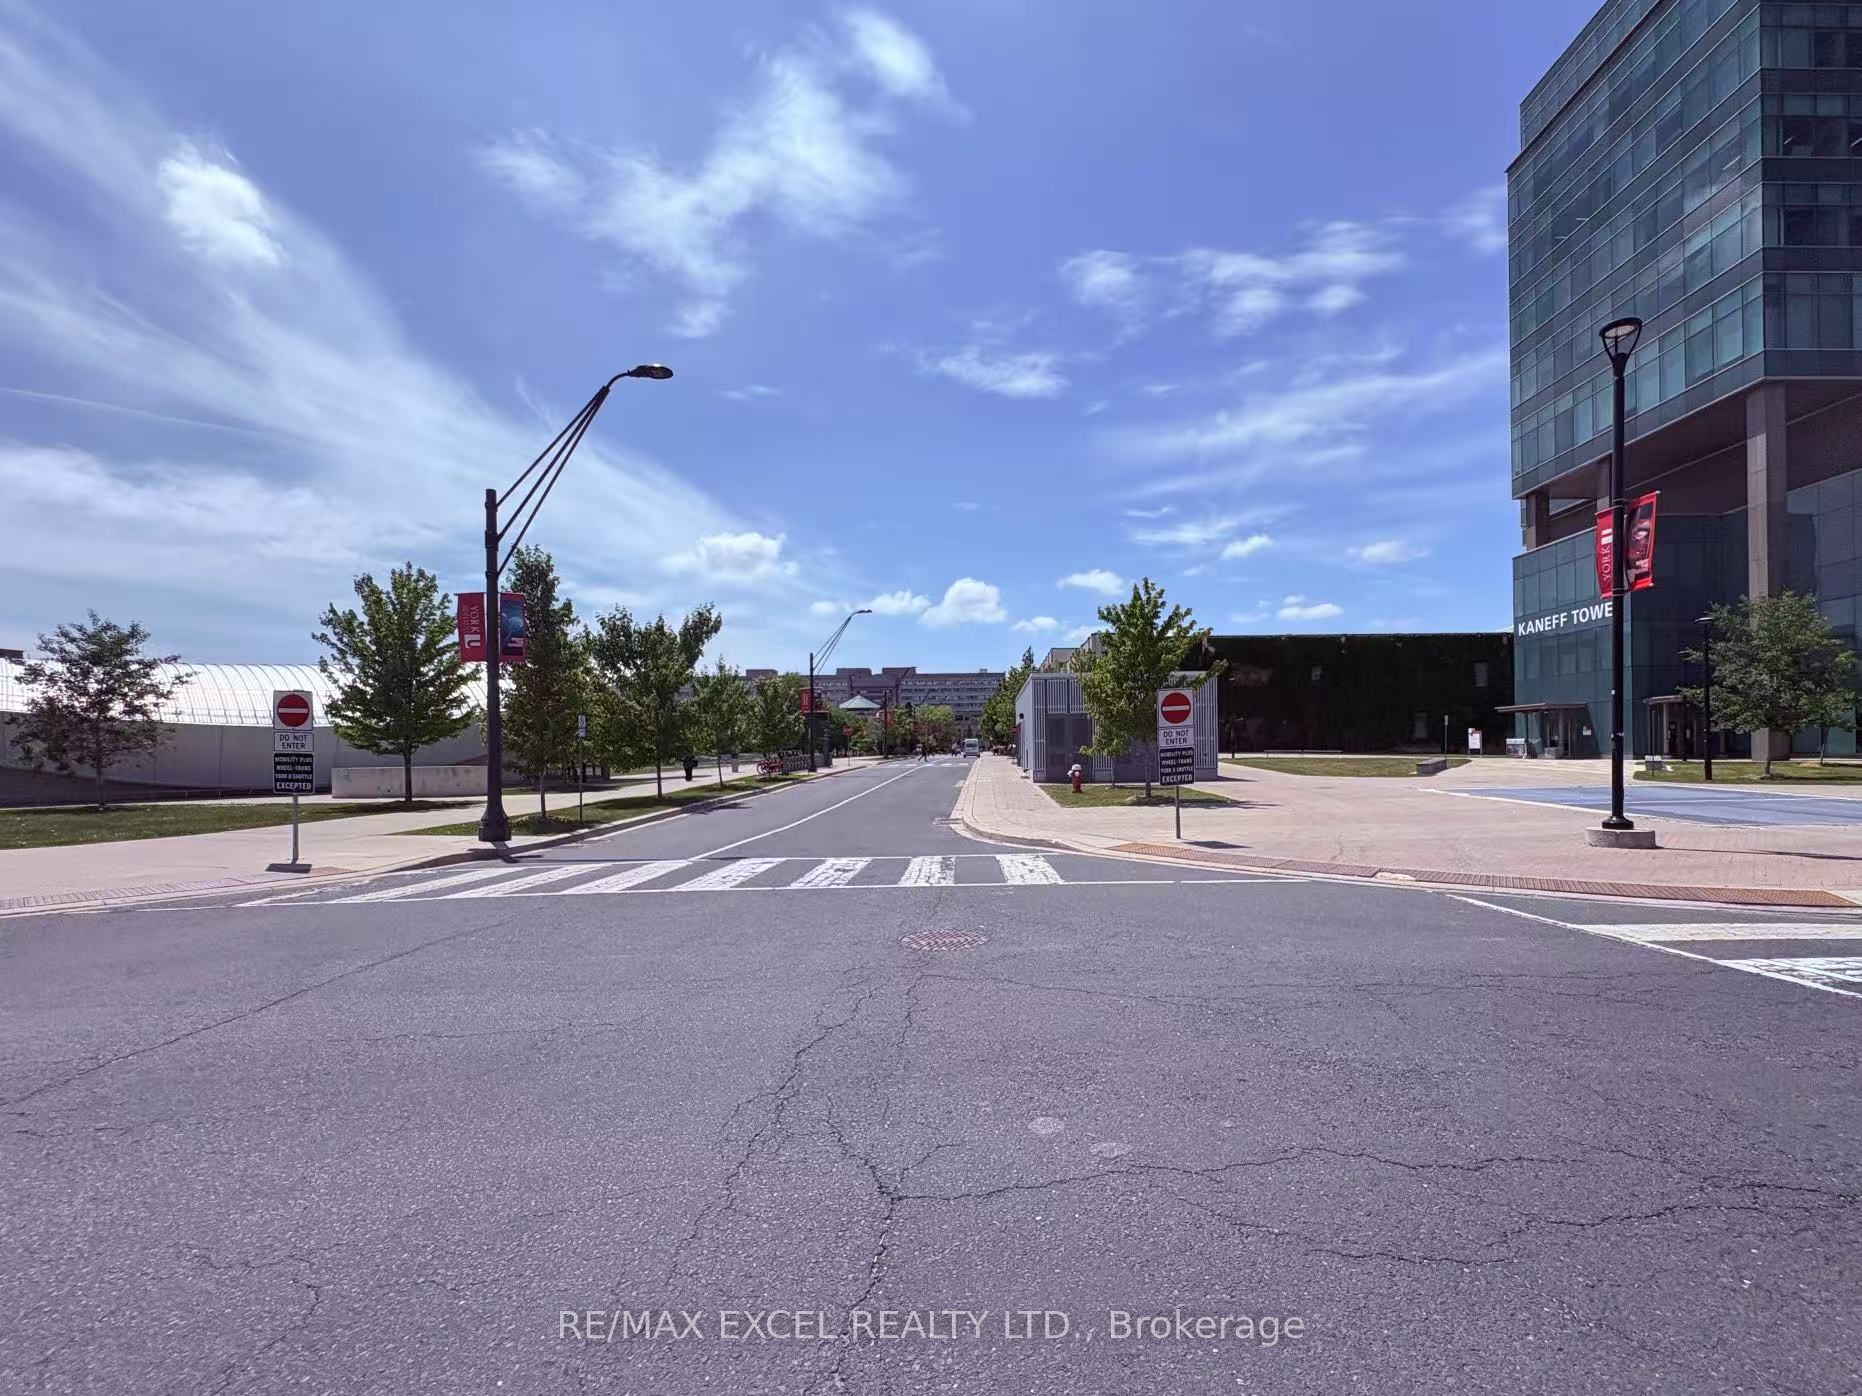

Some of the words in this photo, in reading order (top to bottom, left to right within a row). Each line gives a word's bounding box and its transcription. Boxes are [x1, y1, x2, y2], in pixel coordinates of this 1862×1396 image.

[1601, 543, 1611, 581] YORK
[470, 605, 480, 633] YORK
[1518, 612, 1568, 637] KANEFF
[1571, 601, 1613, 625] TOWE
[293, 734, 307, 742] NOT
[1165, 737, 1187, 745] ENTER
[1162, 774, 1192, 783] EXCEPTED
